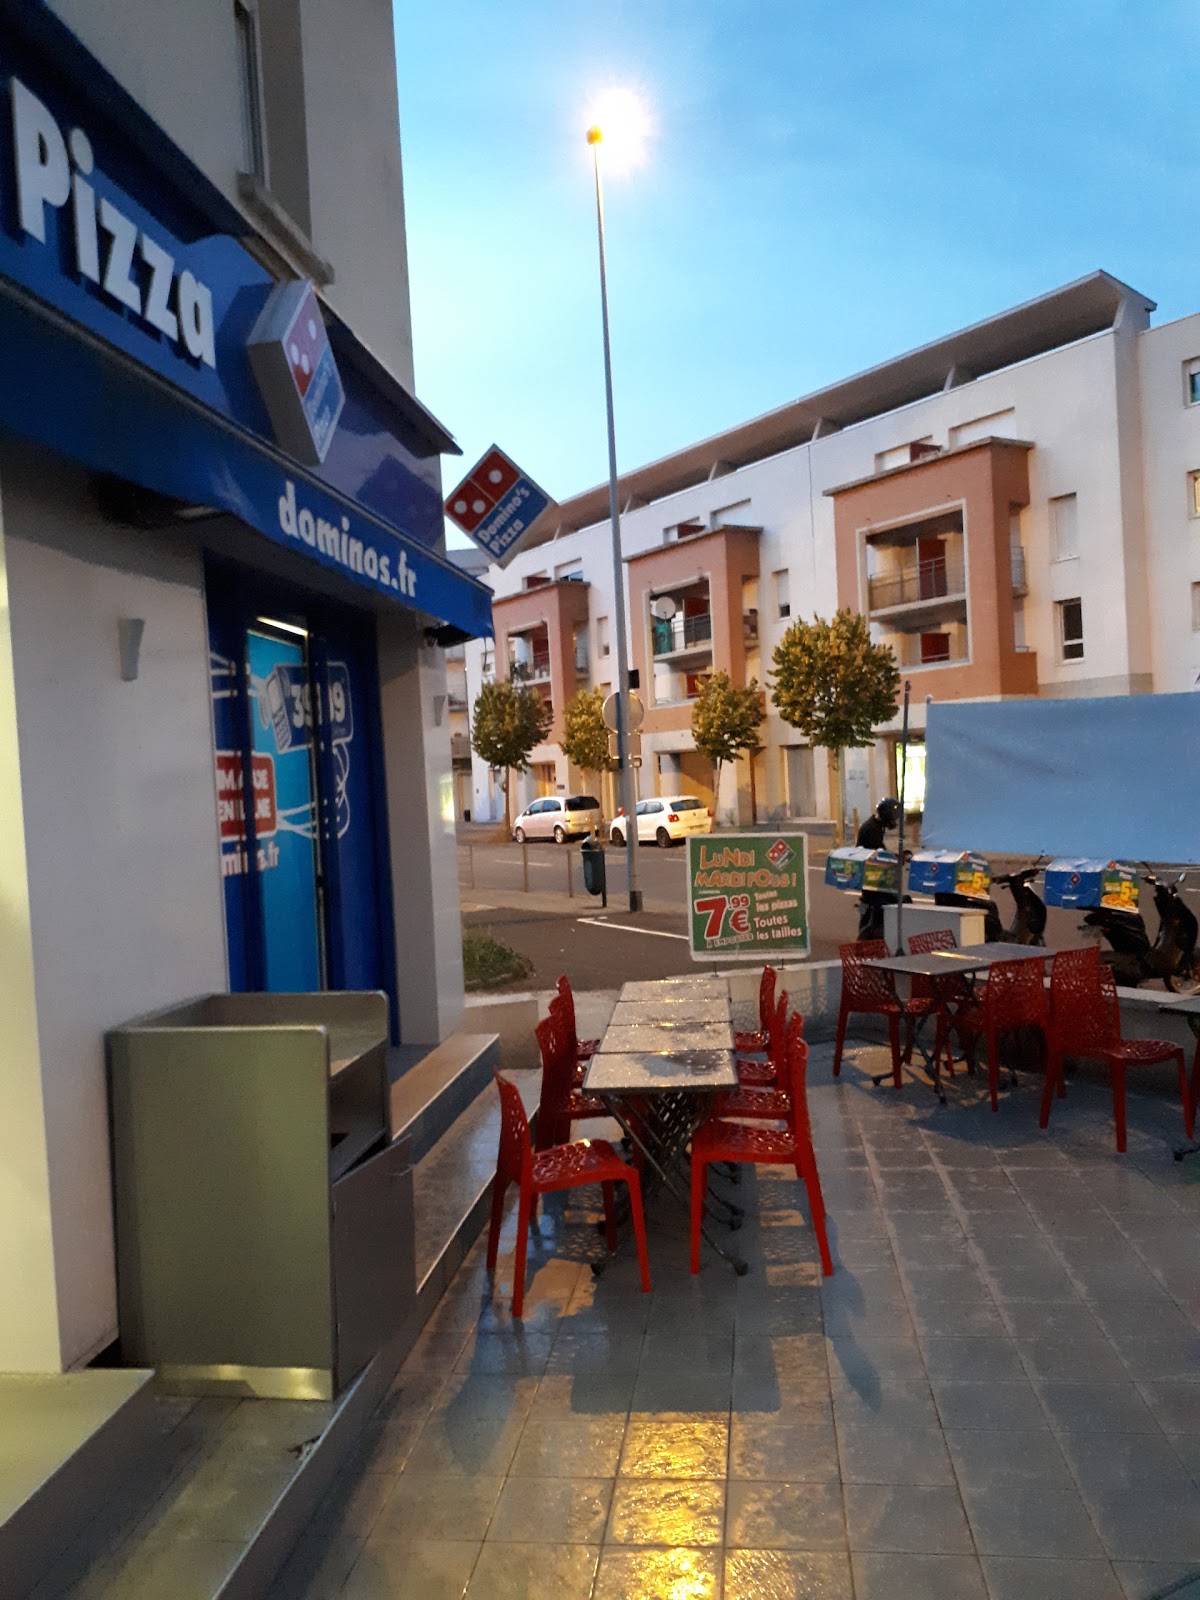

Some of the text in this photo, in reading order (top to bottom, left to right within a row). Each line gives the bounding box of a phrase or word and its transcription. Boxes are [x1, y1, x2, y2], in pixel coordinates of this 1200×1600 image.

[12, 76, 216, 369] Pizza
[477, 487, 531, 544] Domino's
[278, 480, 417, 598] dominos.fr
[489, 519, 524, 554] Pizza
[753, 914, 788, 928] Toutes
[756, 899, 798, 913] les pizzas
[757, 926, 802, 941] les tailles
